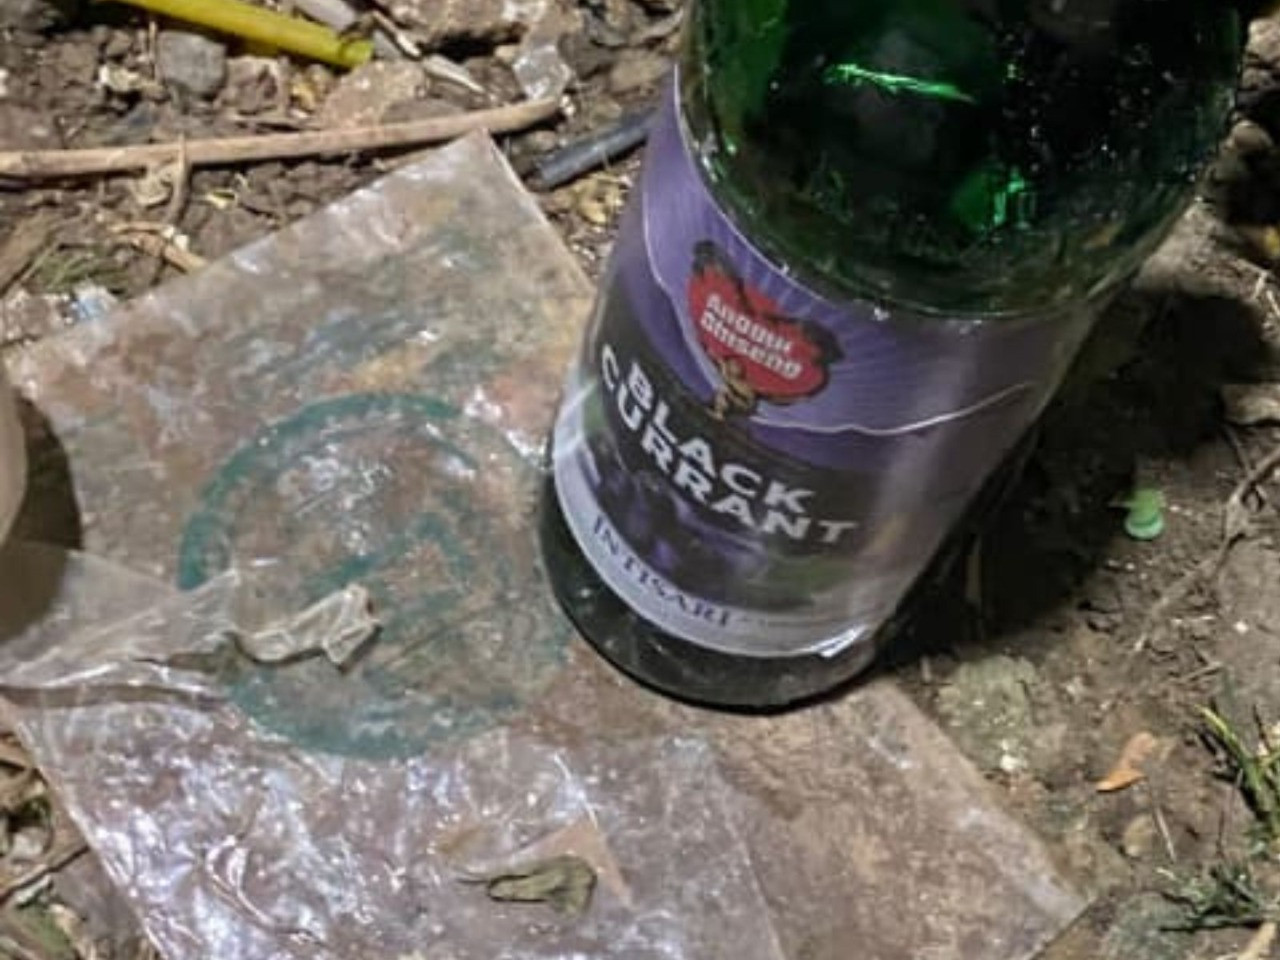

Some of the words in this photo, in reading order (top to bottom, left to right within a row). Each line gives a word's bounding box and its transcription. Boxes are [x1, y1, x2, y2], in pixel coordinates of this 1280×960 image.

[601, 343, 857, 543] CURRANT
[628, 359, 815, 513] BLACK
[594, 515, 730, 627] INTISARI
